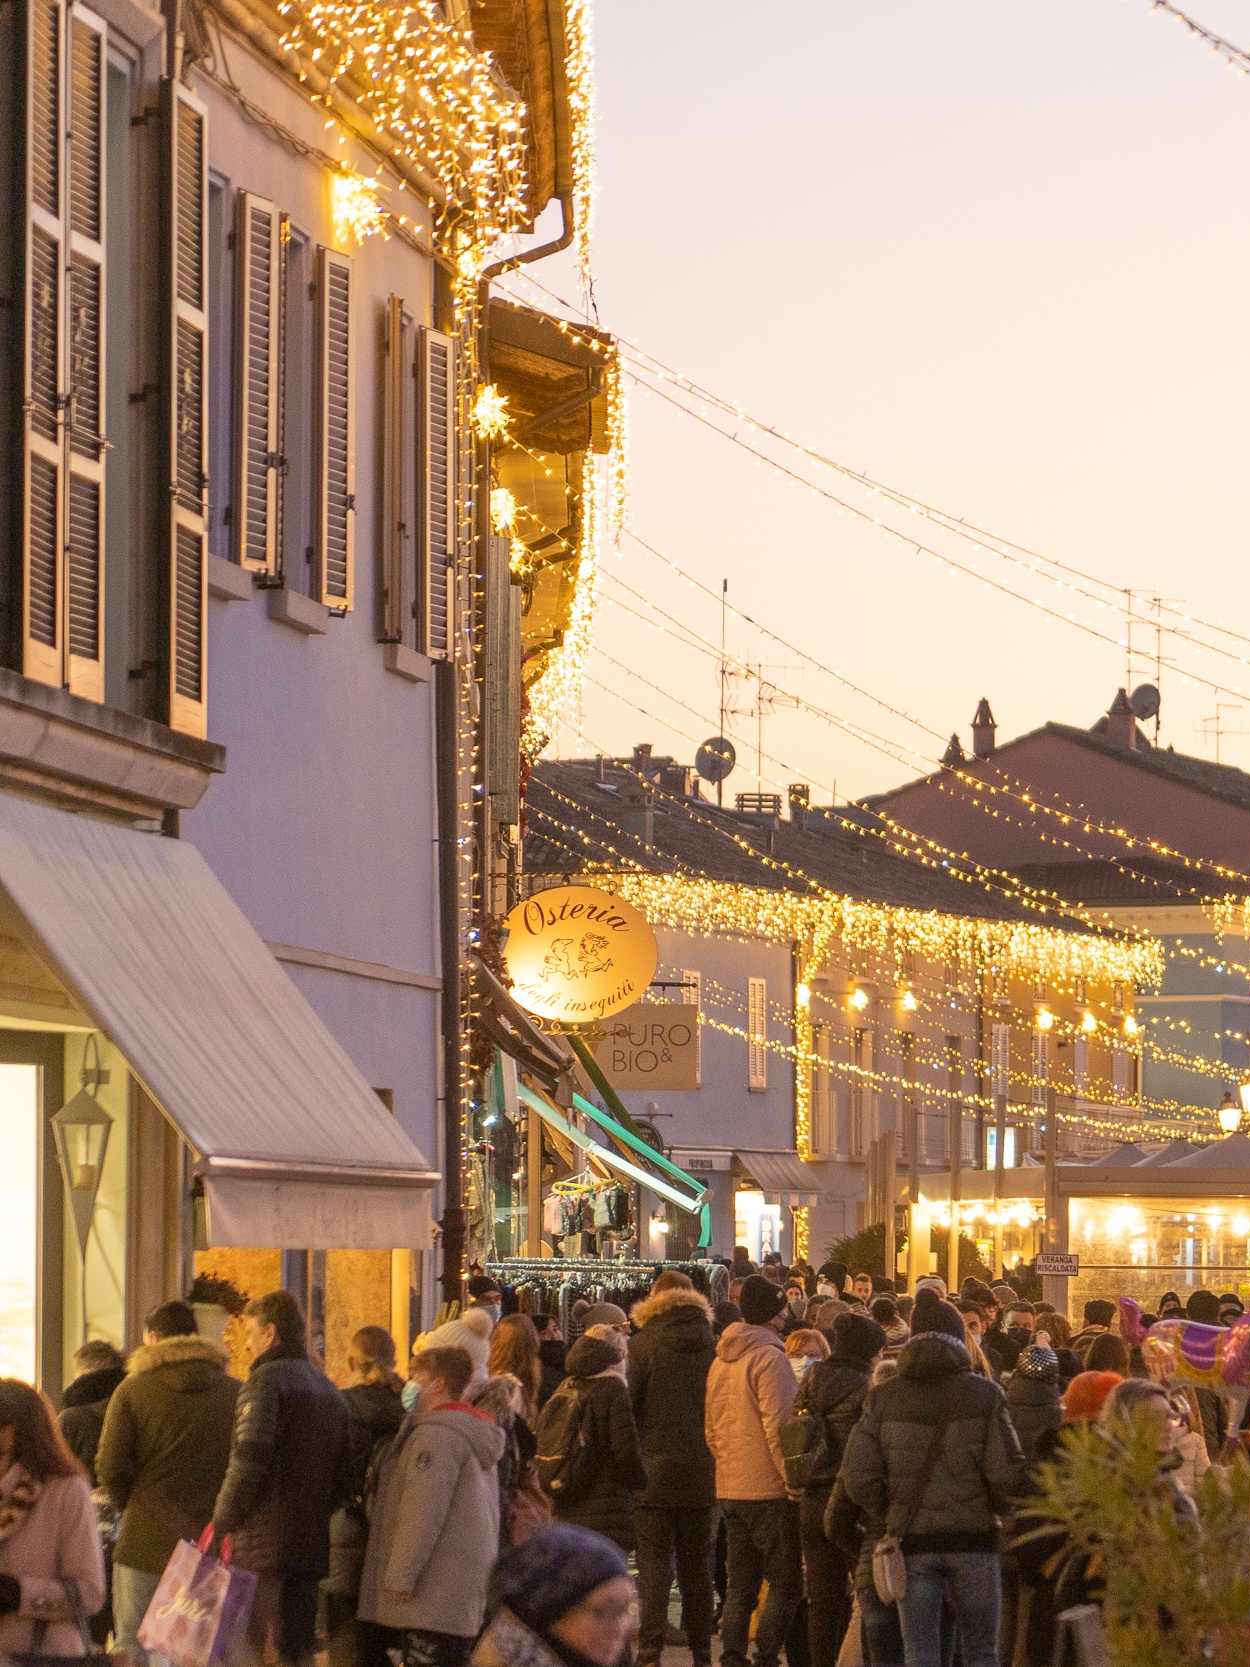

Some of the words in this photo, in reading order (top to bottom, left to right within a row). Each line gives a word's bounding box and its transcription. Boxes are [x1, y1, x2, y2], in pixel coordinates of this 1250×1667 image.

[523, 897, 630, 936] Osteria
[518, 983, 561, 1007] degli
[564, 979, 635, 1016] inseguiti
[613, 1023, 691, 1047] PURO
[1037, 1264, 1078, 1273] RISCALDATA
[1041, 1255, 1073, 1264] VERANDA
